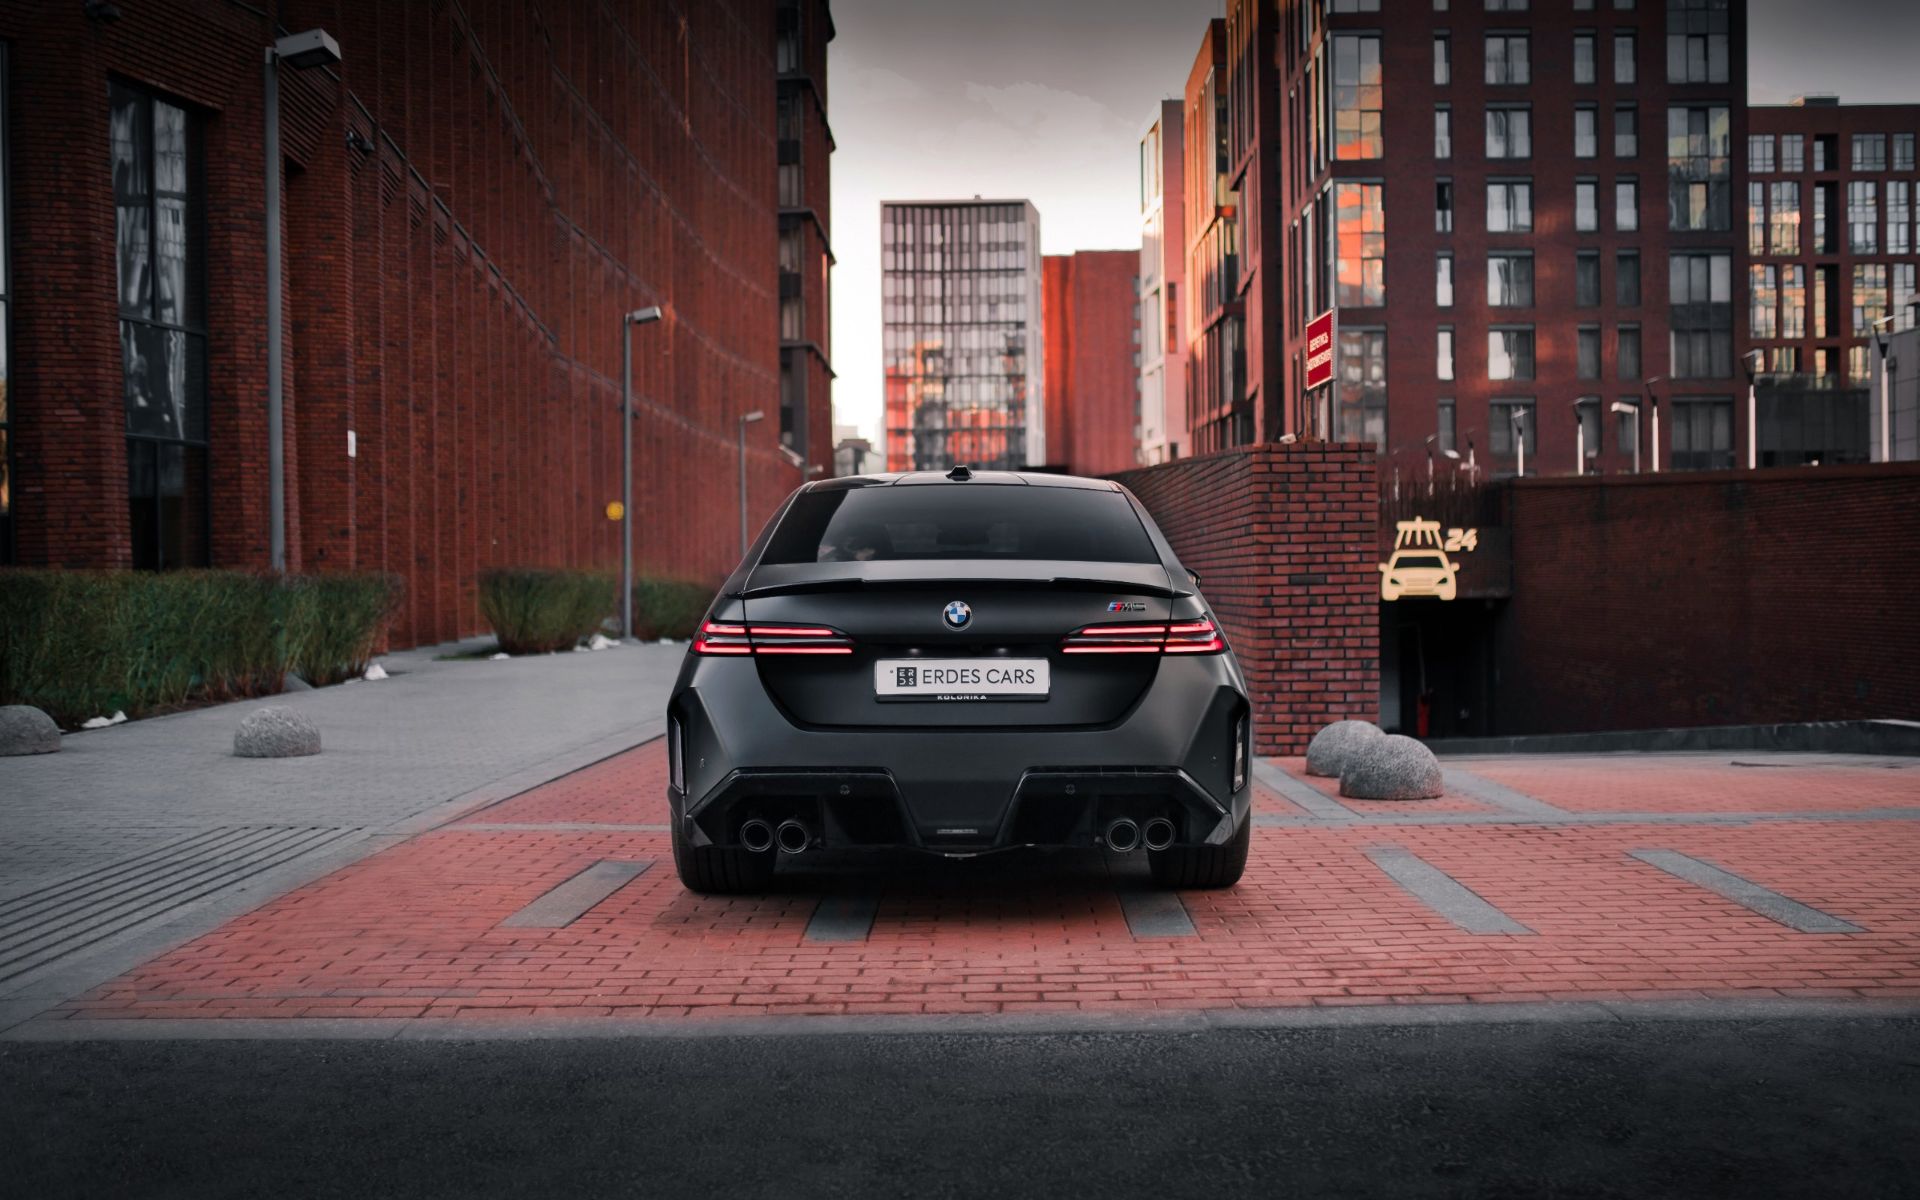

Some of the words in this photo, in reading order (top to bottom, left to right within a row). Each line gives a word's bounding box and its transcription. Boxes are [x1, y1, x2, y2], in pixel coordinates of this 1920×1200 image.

[1444, 528, 1477, 551] 24
[922, 669, 981, 684] ERDES
[986, 668, 1035, 684] CARS
